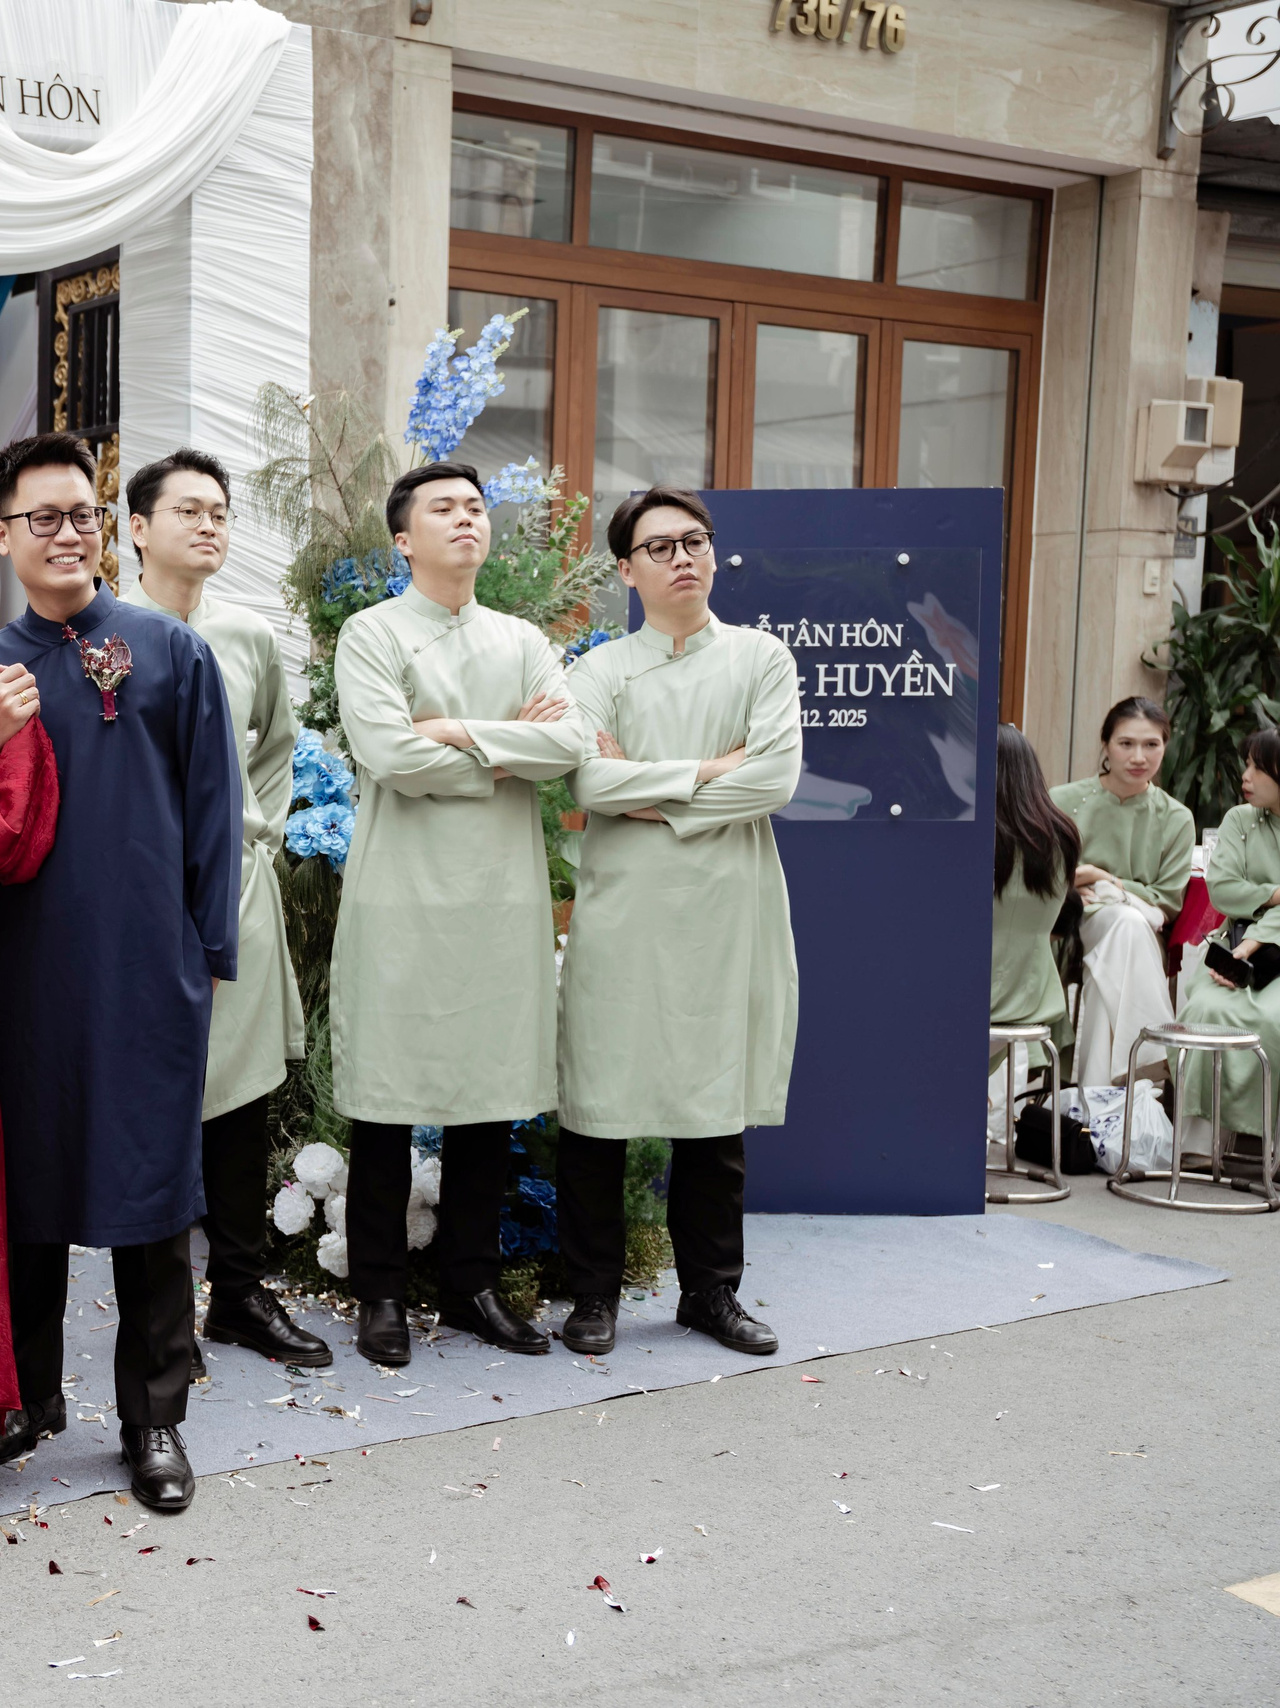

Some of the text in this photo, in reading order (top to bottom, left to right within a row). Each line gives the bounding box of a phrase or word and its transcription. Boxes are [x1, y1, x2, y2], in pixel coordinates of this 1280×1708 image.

[16, 73, 101, 125] HÔN
[777, 617, 835, 647] TÂN
[840, 617, 904, 647] HÔN
[814, 649, 957, 697] HUYỀN
[828, 709, 867, 727] 2025
